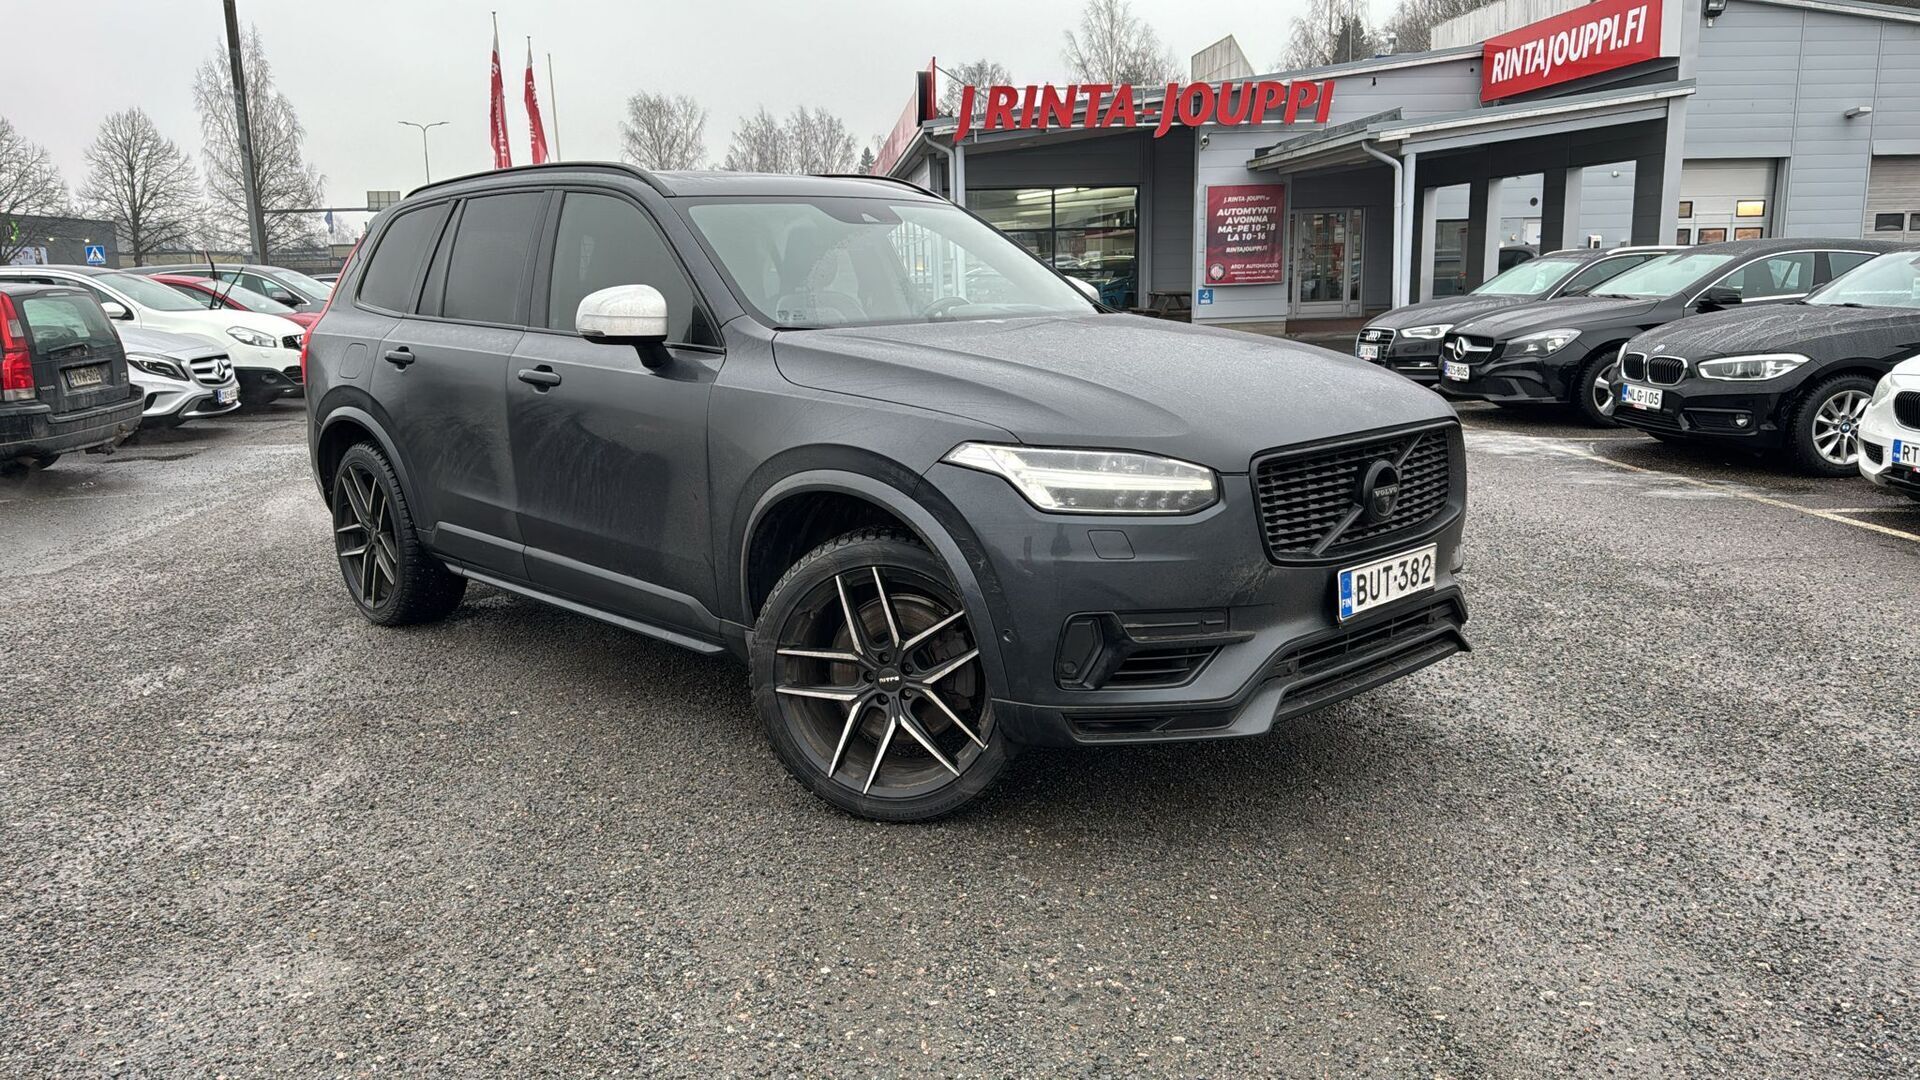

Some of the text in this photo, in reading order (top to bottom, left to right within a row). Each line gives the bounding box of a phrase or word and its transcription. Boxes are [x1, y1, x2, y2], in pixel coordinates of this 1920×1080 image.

[1490, 4, 1648, 84] RINTAJOUPPI.FI
[953, 79, 1335, 143] J RINTA-JOUPPI
[1216, 207, 1276, 216] AUTOMYYNTI
[1226, 216, 1268, 224] AVOINNA
[1627, 387, 1660, 405] NLG-105
[1374, 486, 1398, 497] VOLVO
[1356, 553, 1432, 606] BUT-382
[1341, 598, 1352, 609] FIN
